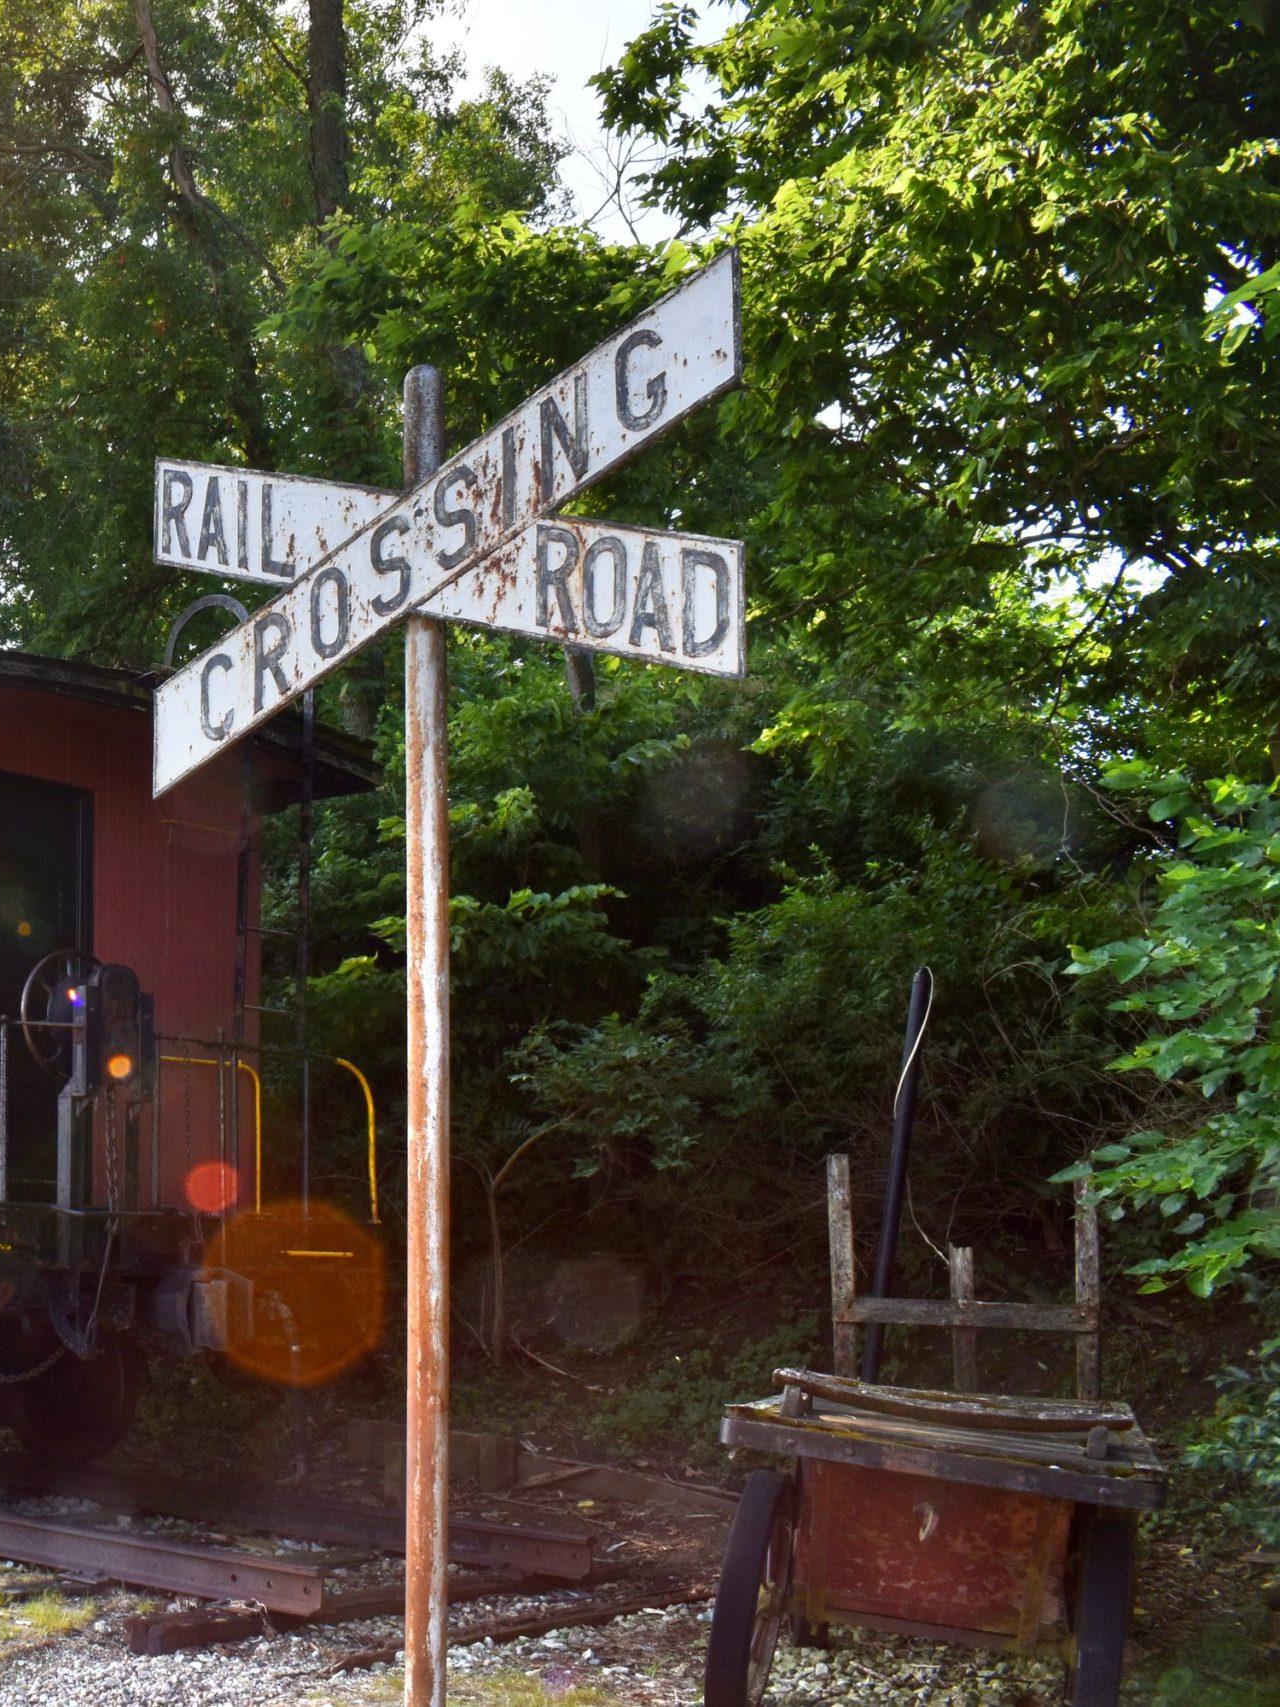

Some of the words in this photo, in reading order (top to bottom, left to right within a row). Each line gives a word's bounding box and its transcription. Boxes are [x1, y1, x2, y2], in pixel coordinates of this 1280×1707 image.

[162, 470, 296, 577] RAIL
[536, 524, 732, 659] ROAD
[199, 329, 668, 742] CROSSING
